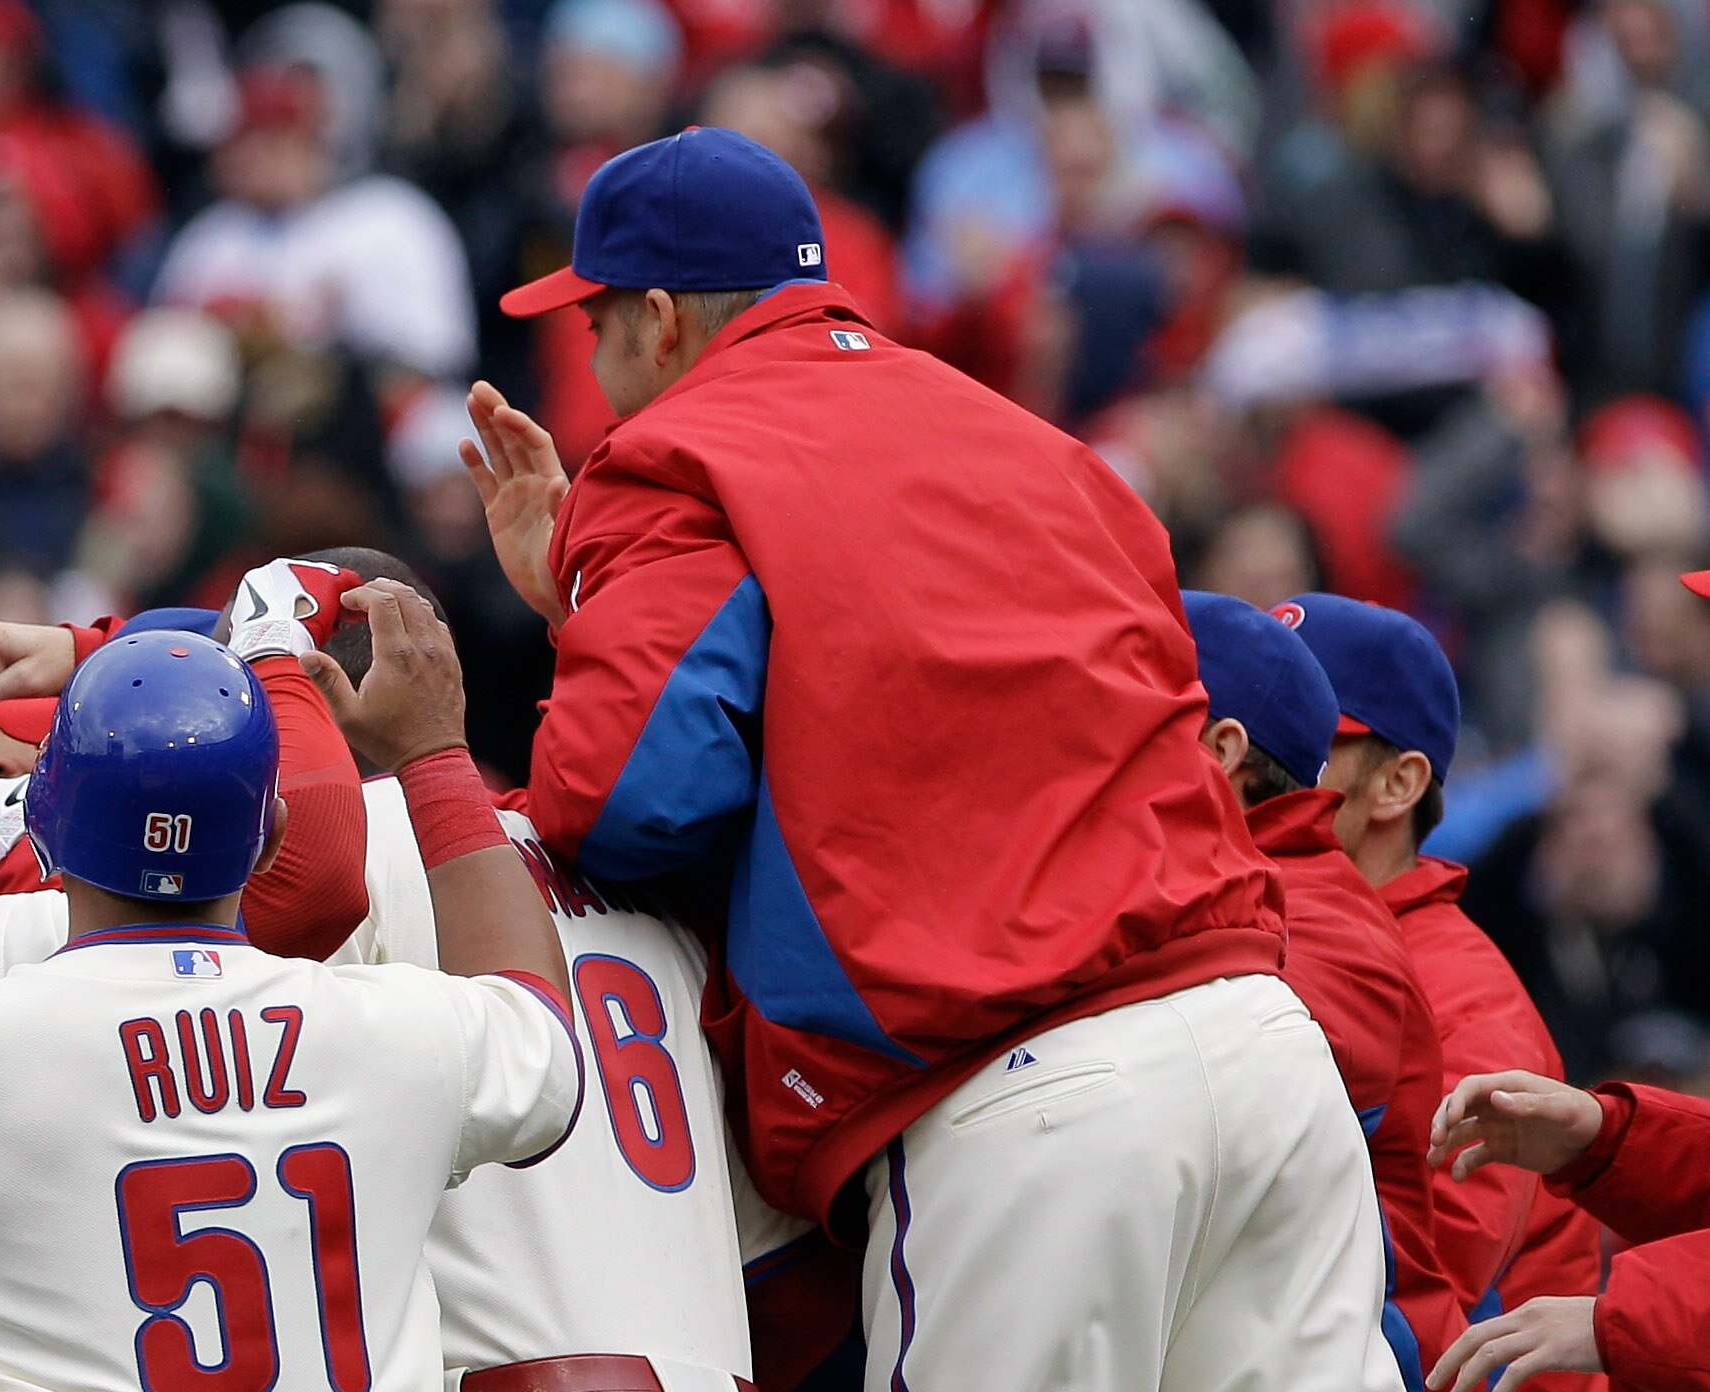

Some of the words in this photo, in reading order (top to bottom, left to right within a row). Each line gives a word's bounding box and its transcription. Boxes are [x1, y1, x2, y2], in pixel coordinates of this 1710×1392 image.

[143, 812, 193, 853] 51
[118, 1005, 307, 1123] RUIZ
[572, 953, 696, 1193] 6
